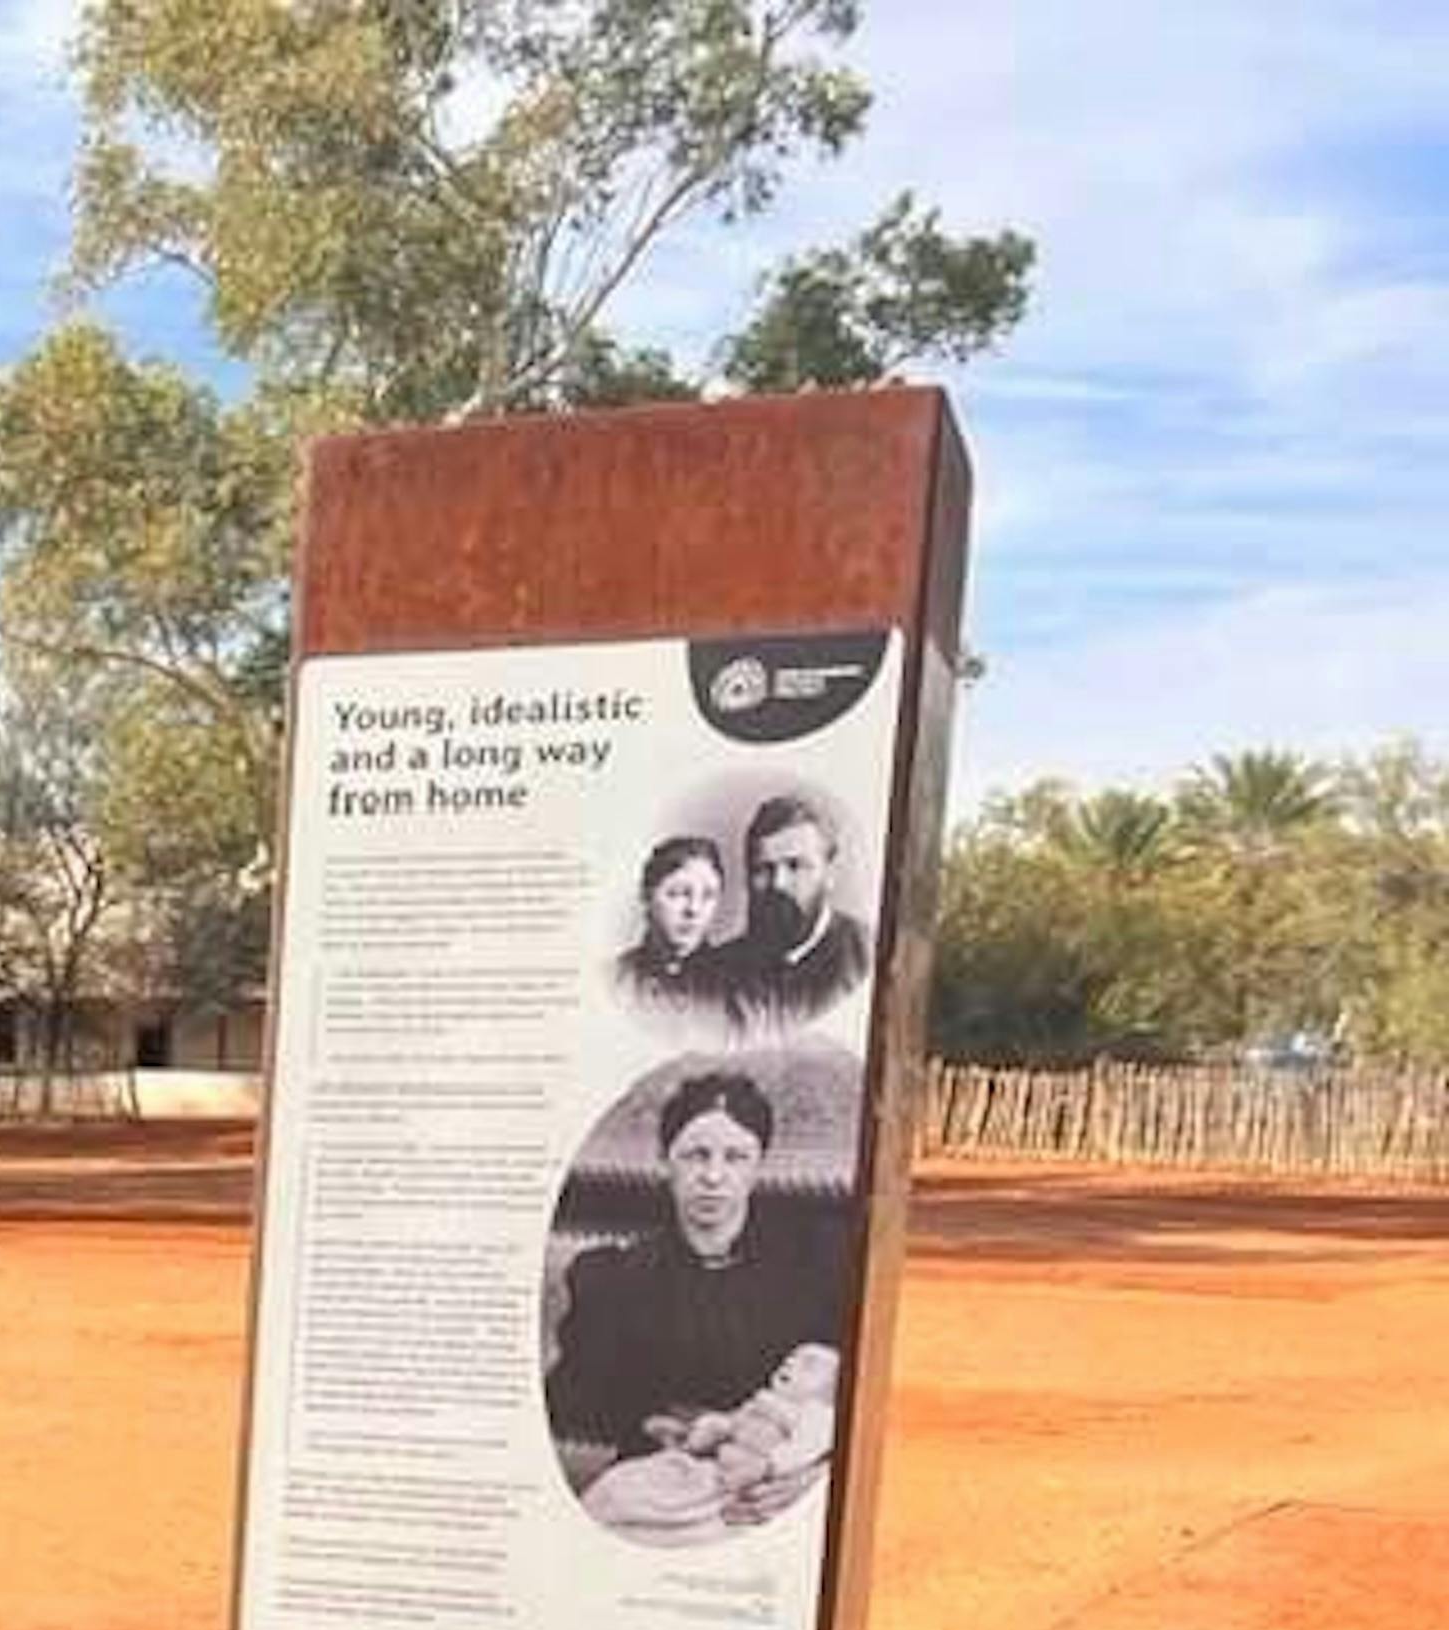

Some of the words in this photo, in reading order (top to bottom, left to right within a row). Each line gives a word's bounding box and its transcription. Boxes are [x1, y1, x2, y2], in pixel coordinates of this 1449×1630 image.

[334, 702, 455, 735] Young,
[469, 689, 644, 725] idealistic
[329, 741, 396, 774] and
[407, 748, 429, 770] a
[442, 738, 522, 774] long
[535, 740, 612, 769] way
[328, 783, 415, 816] from
[426, 780, 529, 808] home
